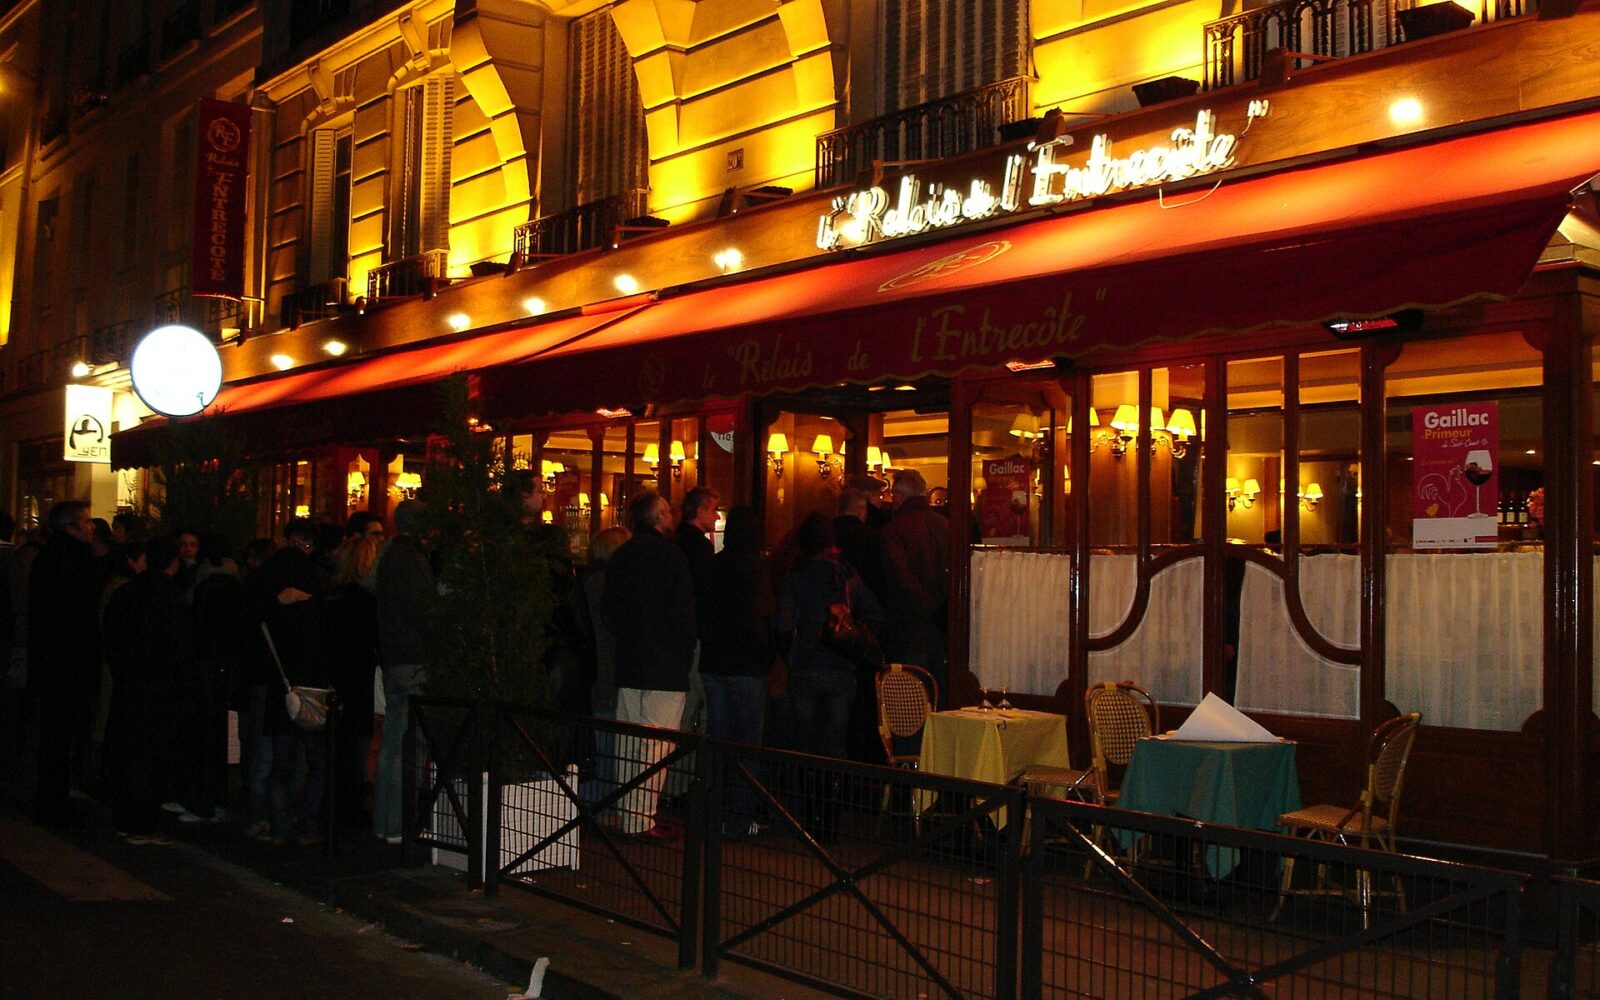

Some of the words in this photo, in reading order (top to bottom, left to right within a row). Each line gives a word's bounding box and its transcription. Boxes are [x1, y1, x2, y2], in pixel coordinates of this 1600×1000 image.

[847, 339, 870, 371] de
[1424, 408, 1489, 429] Gaillac
[1424, 427, 1472, 440] Primeur
[989, 461, 1025, 475] Gaillac
